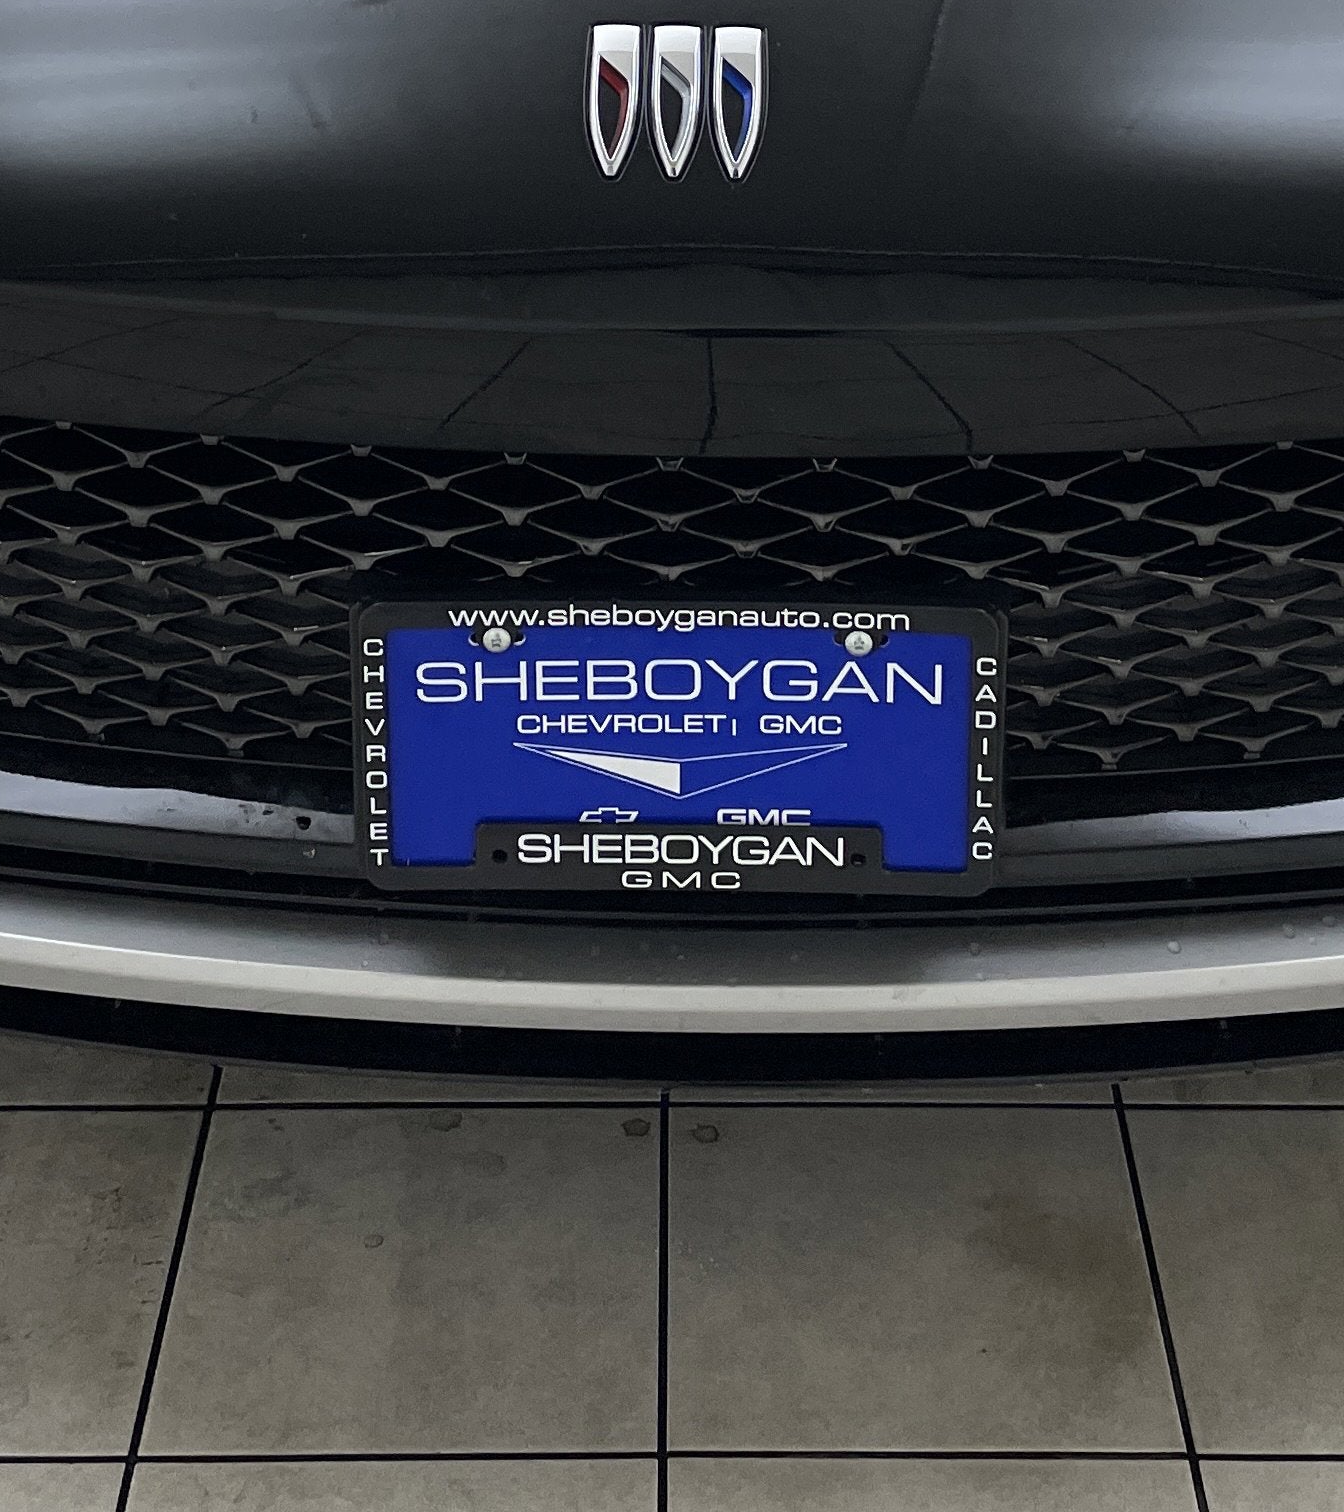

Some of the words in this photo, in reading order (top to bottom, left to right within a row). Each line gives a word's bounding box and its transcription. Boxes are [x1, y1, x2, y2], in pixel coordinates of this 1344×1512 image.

[448, 603, 910, 632] www.sheboyganauto.com
[415, 658, 943, 705] SHEBOYGAN
[759, 715, 842, 735] GMC
[363, 638, 389, 867] CHEVROLET
[971, 657, 998, 861] CADILLAC
[717, 808, 811, 827] GMC
[517, 834, 844, 867] SHEBOYGAN
[621, 871, 741, 889] GMC
